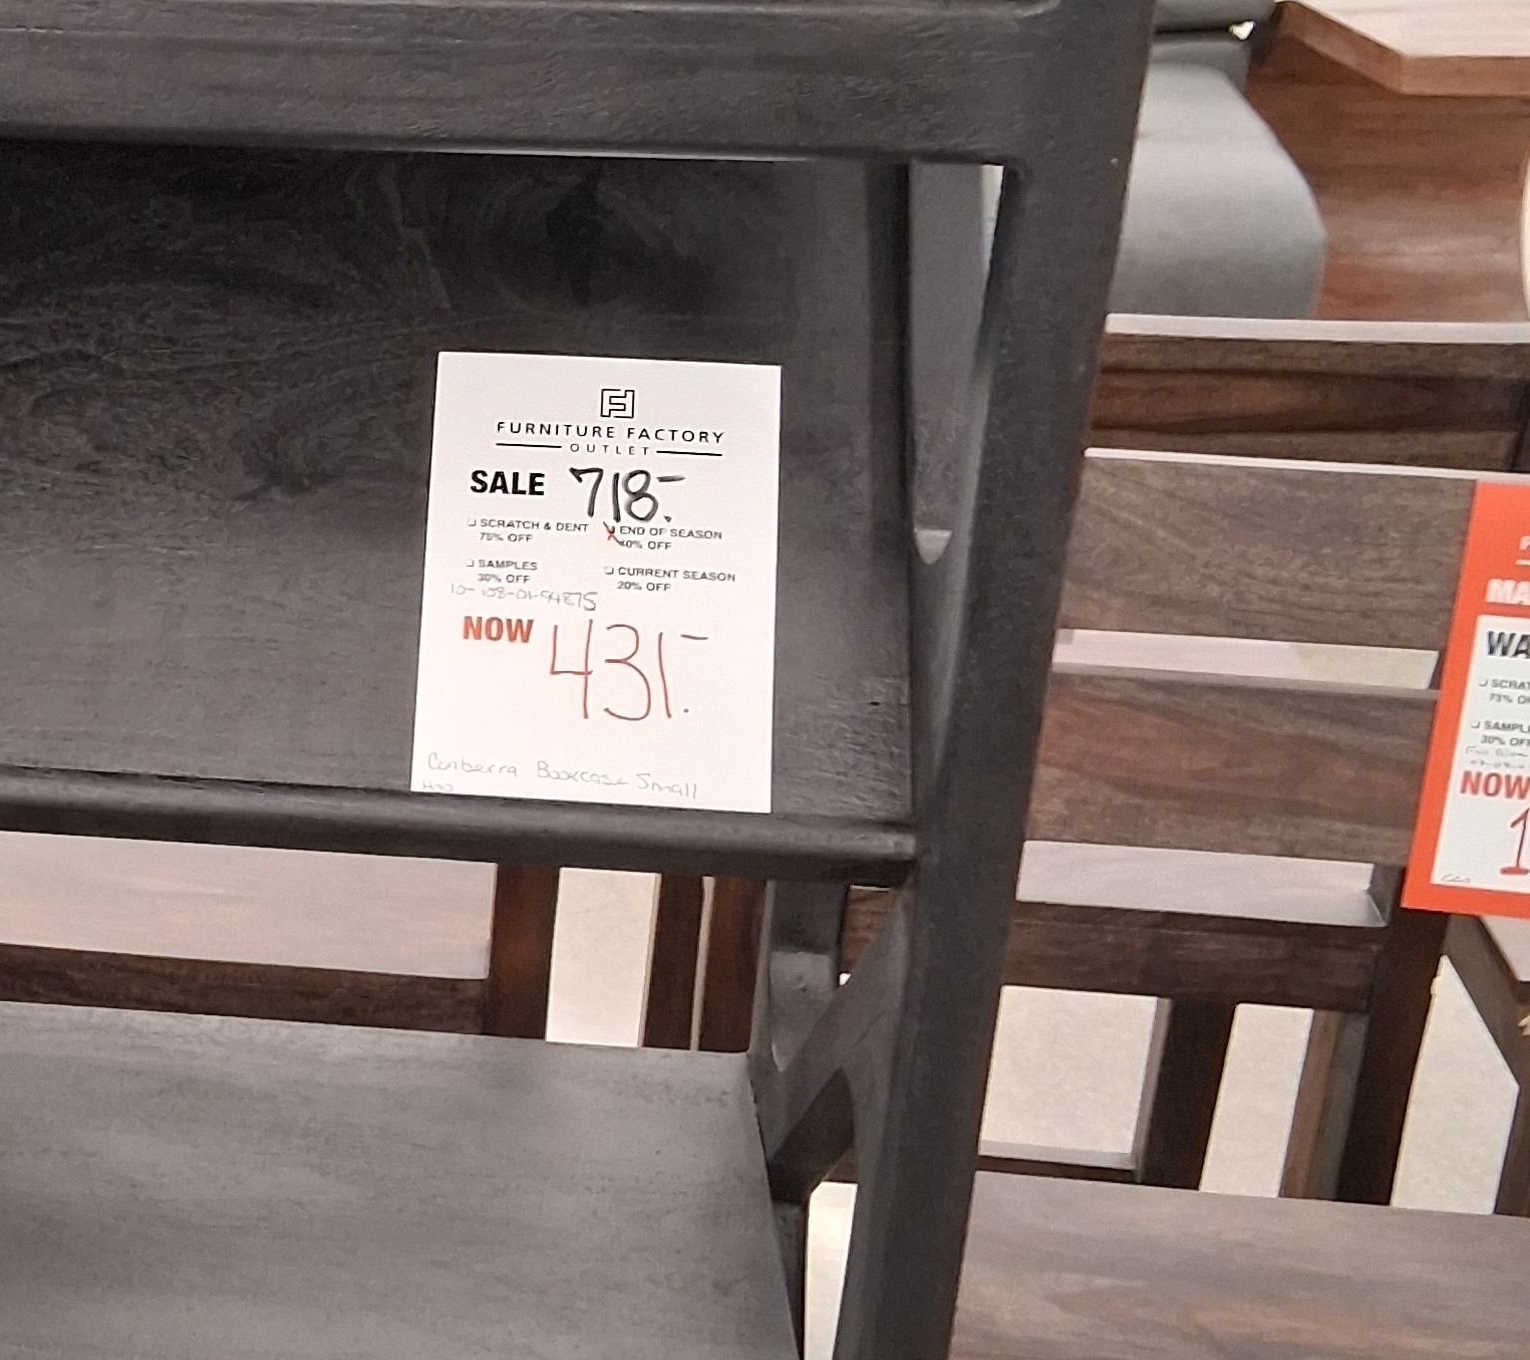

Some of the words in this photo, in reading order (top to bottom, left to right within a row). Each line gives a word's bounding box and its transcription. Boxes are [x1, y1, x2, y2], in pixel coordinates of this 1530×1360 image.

[496, 421, 616, 439] FURNITURE
[626, 426, 725, 444] FACTORY
[569, 443, 650, 456] OUTLET
[469, 469, 546, 496] SALE
[480, 518, 540, 530] SCRATCH
[543, 521, 551, 531] &
[556, 521, 589, 532] DENT
[507, 533, 533, 542] OFF
[619, 525, 646, 536] END
[649, 526, 667, 536] OF
[670, 528, 723, 540] SEASON
[647, 540, 672, 550] OFF
[478, 559, 538, 571] SAMPLES
[505, 574, 531, 584] OFF
[618, 566, 679, 578] CURRENT
[682, 570, 736, 582] SEASON
[617, 581, 642, 591] 20%
[646, 582, 672, 592] OFF
[462, 615, 535, 644] NOW
[635, 772, 698, 799] Small
[1460, 769, 1530, 800] NOW
